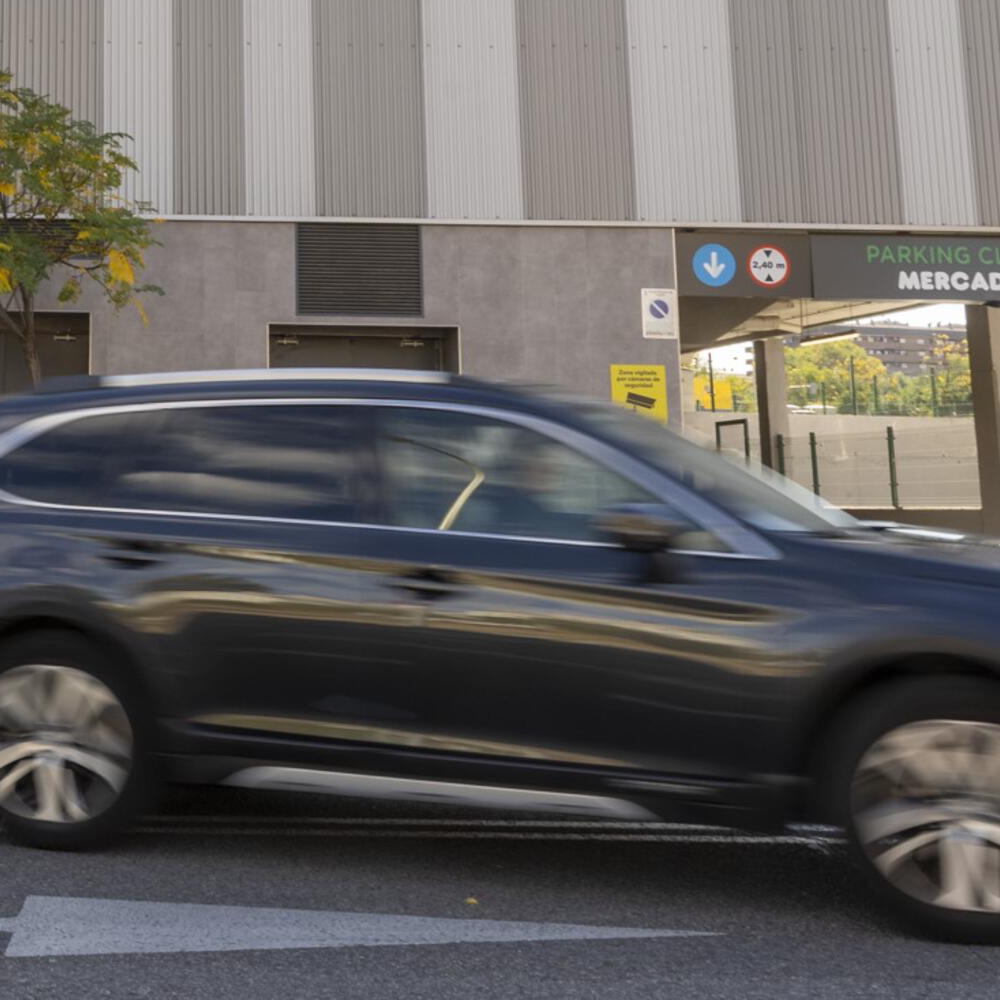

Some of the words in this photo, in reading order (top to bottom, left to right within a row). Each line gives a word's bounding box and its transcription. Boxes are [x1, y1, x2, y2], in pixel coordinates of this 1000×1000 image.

[867, 245, 971, 265] PARKING
[752, 261, 774, 270] 2,40
[898, 271, 1000, 291] MERCAD
